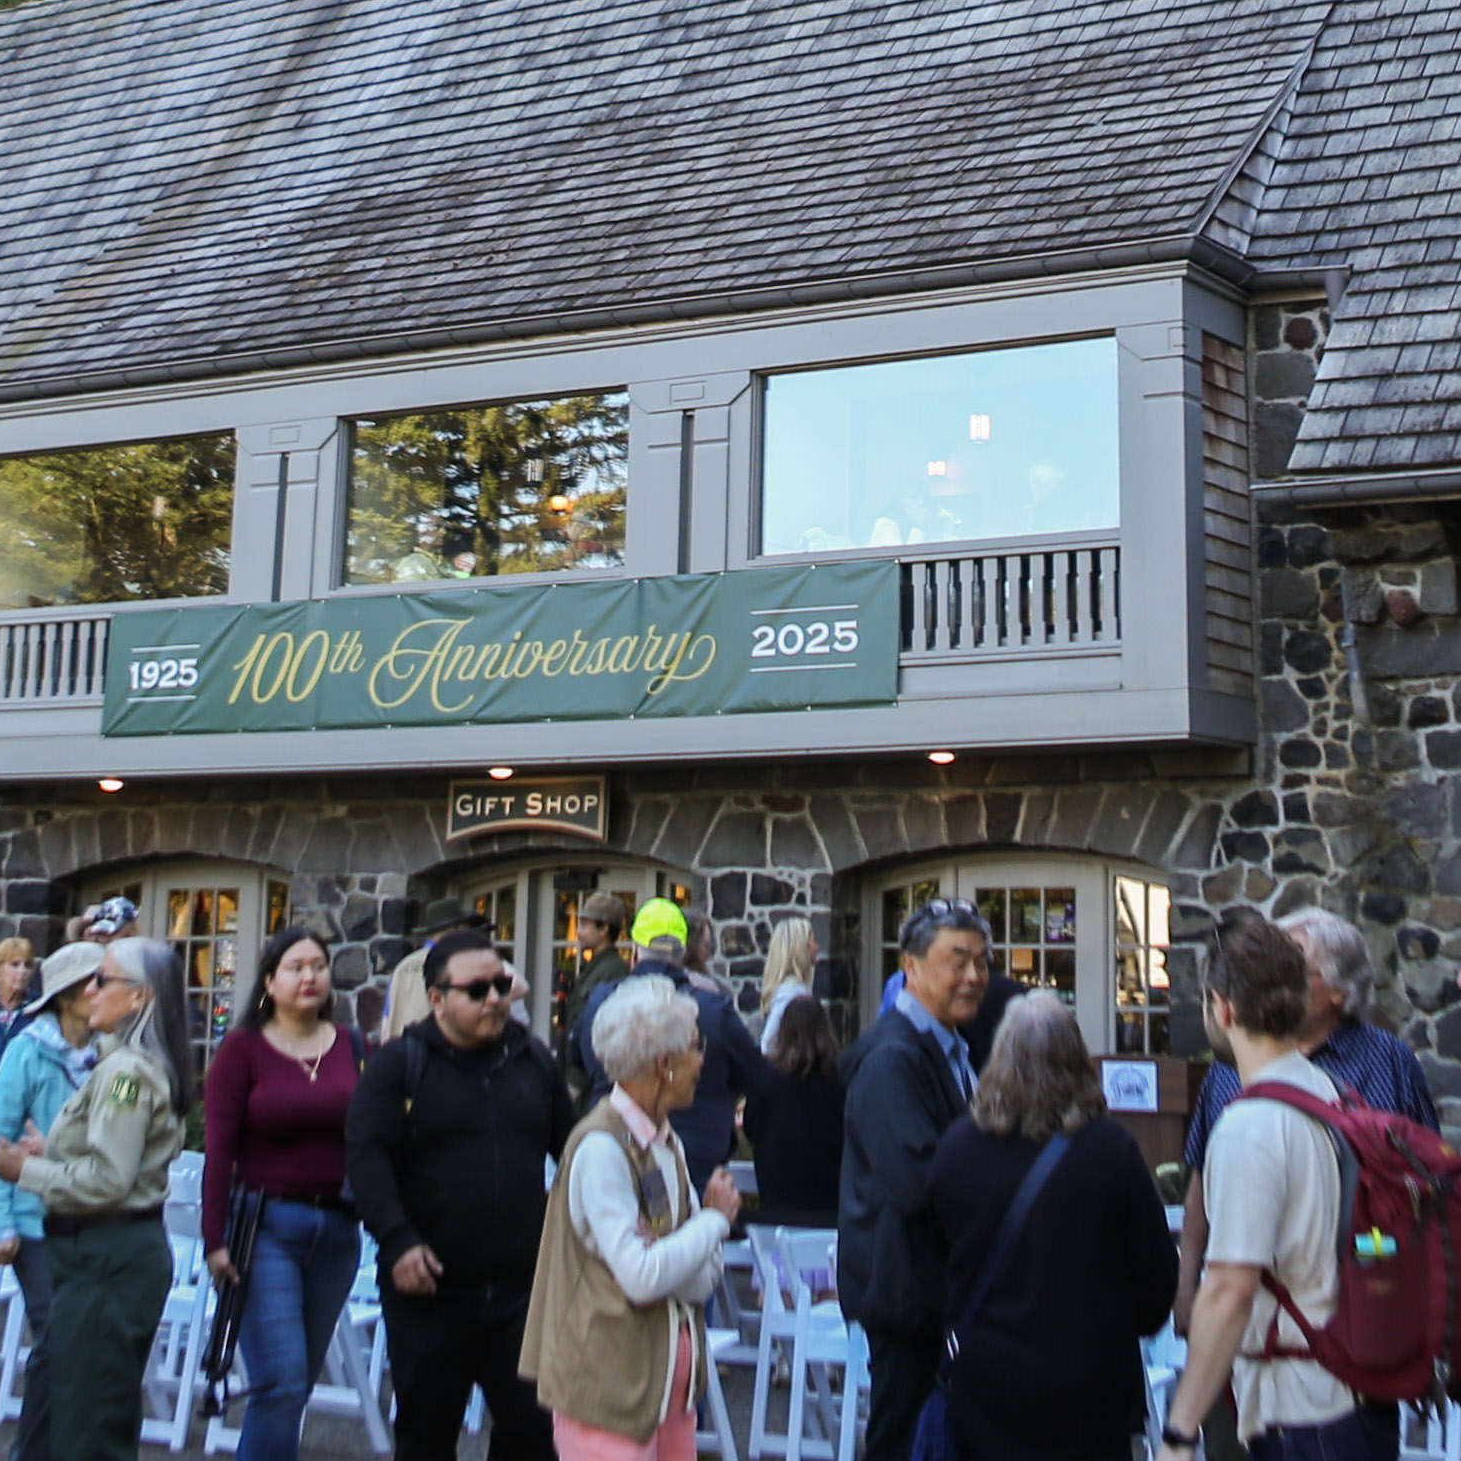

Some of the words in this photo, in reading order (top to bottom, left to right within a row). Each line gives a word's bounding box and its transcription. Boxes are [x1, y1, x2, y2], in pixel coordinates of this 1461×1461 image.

[751, 620, 859, 658] 2025
[129, 658, 198, 690] 1925
[228, 630, 366, 705] 100th
[368, 616, 717, 714] Anniversary
[456, 794, 515, 817] GIFT
[525, 792, 598, 817] SHOP
